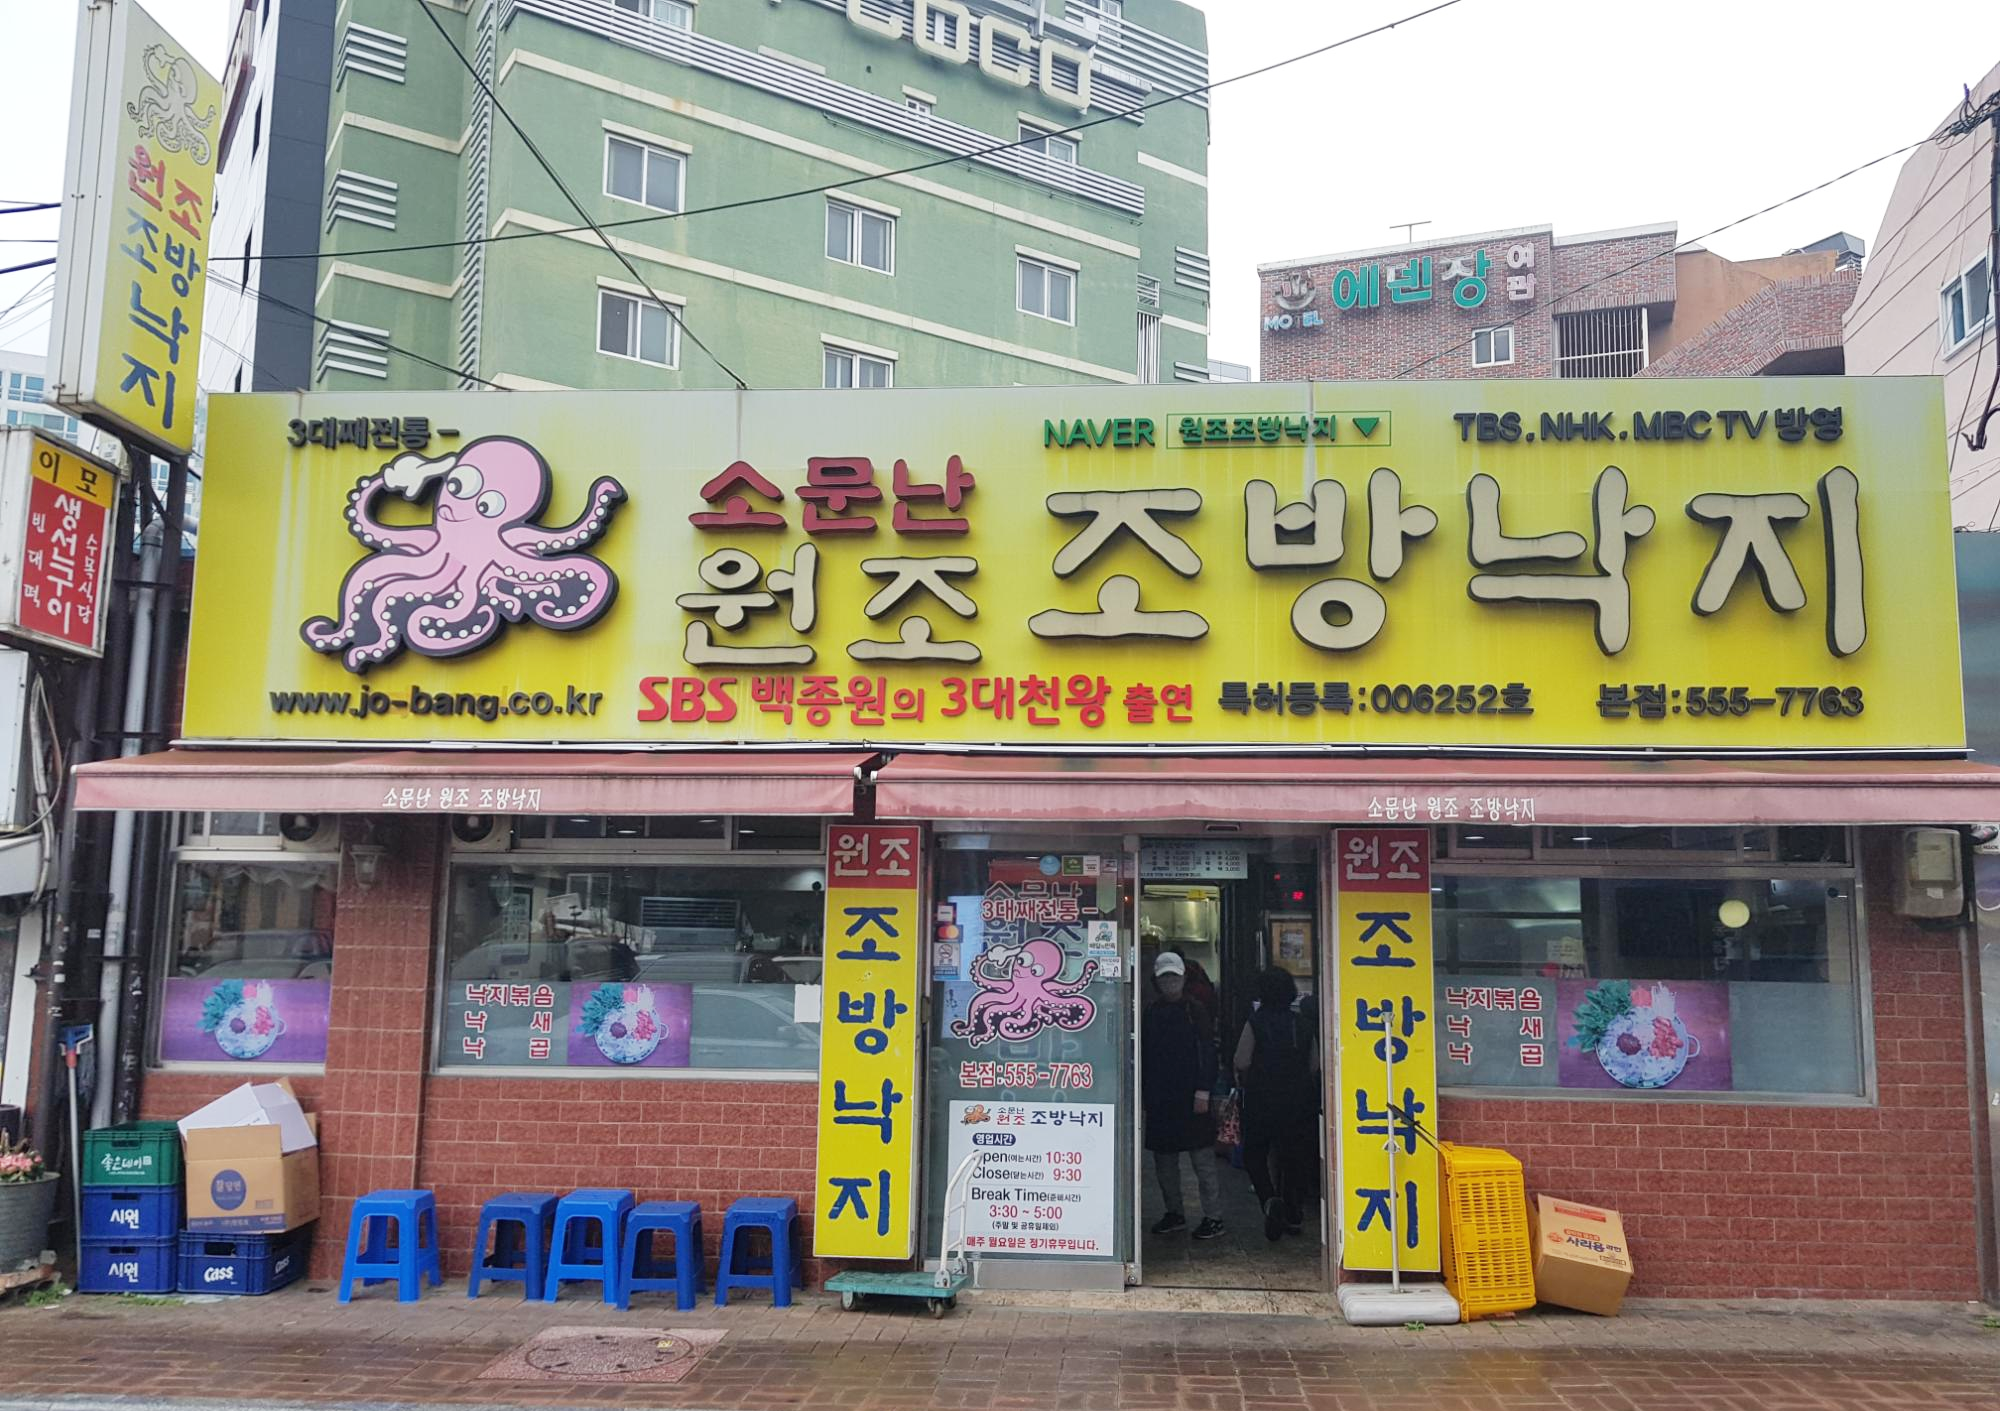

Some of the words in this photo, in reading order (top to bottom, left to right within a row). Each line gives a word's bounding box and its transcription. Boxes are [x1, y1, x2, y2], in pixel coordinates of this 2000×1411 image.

[847, 0, 1091, 109] COCO
[128, 144, 203, 241] 원조
[1506, 242, 1537, 301] 여관
[119, 206, 201, 430] 조방낙지
[1264, 310, 1324, 332] MOEL
[287, 416, 431, 450] 3대째전통
[1044, 417, 1156, 449] NAVER
[1178, 414, 1337, 443] 원조조방낙지
[1774, 405, 1843, 442] 방영
[39, 451, 98, 498] 이모
[687, 453, 977, 537] 소문난
[23, 511, 46, 609] 빈대떡
[46, 493, 82, 636] 생선구이
[674, 541, 983, 668] 원조
[1027, 464, 1868, 660] 조방낙지
[78, 532, 98, 625] 수목식당
[269, 684, 604, 722] www.jo-bang.co.kr
[636, 676, 739, 723] SBS
[751, 675, 926, 727] 백종원의
[940, 674, 1112, 727] 3대천왕
[1122, 683, 1193, 723] 출연
[1596, 682, 1866, 719] 본점:555-7763
[382, 787, 431, 809] 소문난
[440, 787, 469, 809] 원조
[478, 787, 542, 811] 조방낙지
[1368, 796, 1418, 820] 소문난
[1427, 796, 1459, 820] 원조
[1470, 797, 1536, 821] 조방낙지
[833, 832, 912, 877] 원조
[1343, 837, 1422, 881] 원조
[981, 898, 1080, 923] 3대째전통
[466, 984, 554, 1008] 낙지볶음
[1446, 987, 1543, 1012] 낙지볶음
[827, 905, 908, 1237] 조방낙지
[959, 1060, 1093, 1088] 본점:555-7763
[1351, 910, 1427, 1249] 조방낙지
[996, 1114, 1026, 1126] 원조
[1030, 1109, 1104, 1127] 조방낙지
[997, 1106, 1025, 1115] 소문난
[975, 1133, 1013, 1146] 영업시간
[101, 1152, 143, 1172] 좋은데이
[1045, 1151, 1082, 1165] 10:30
[1053, 1168, 1082, 1182] 9:30
[971, 1186, 1011, 1201] Break
[110, 1208, 140, 1230] 시원
[989, 1204, 1018, 1218] 3:30
[1033, 1205, 1063, 1219] 5:00
[966, 1236, 985, 1247] 매주
[988, 1237, 1026, 1249] 월요일은
[1029, 1238, 1100, 1251] 정기휴무입니다.
[1566, 1236, 1606, 1252] 사리용
[108, 1262, 139, 1282] 시원
[204, 1265, 235, 1284] Cass
